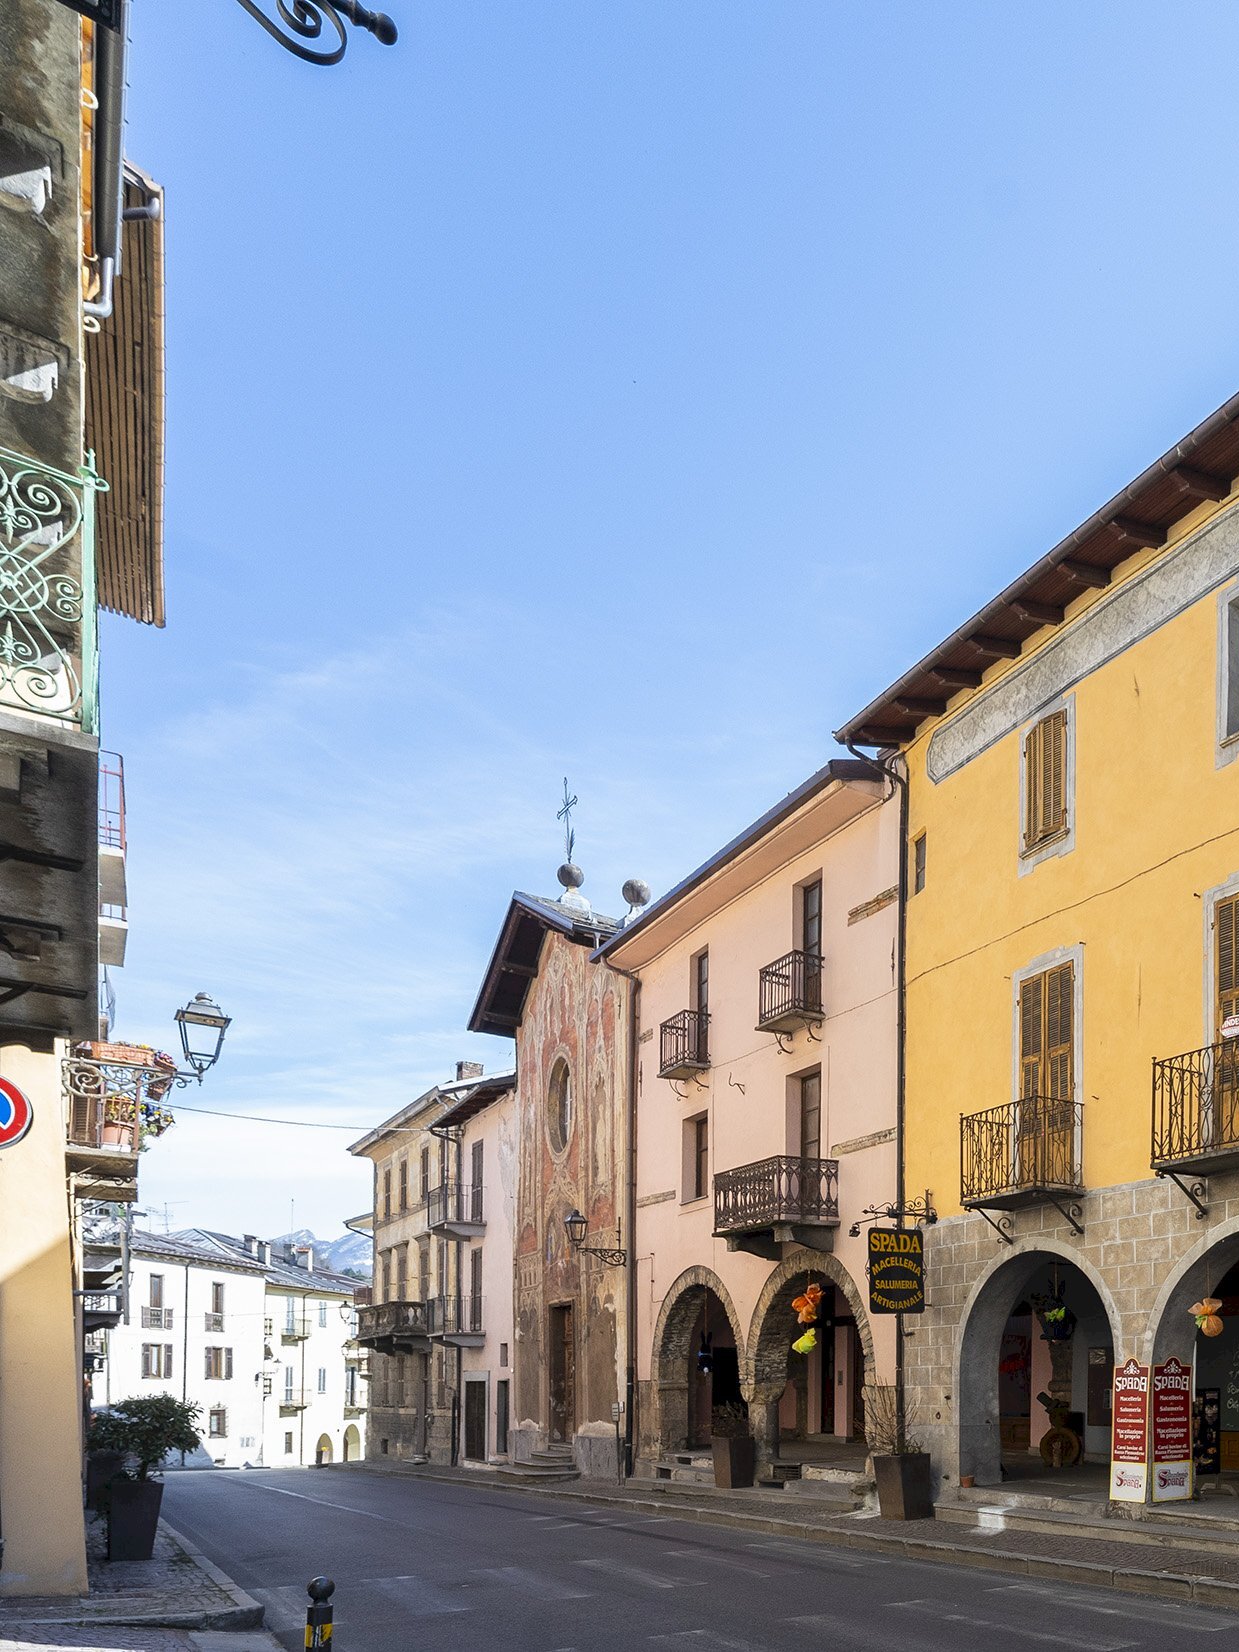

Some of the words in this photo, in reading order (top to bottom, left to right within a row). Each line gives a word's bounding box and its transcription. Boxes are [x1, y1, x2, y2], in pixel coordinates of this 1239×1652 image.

[870, 1232, 922, 1253] SPADA
[872, 1257, 922, 1276] MACELLERIA
[875, 1280, 918, 1290] SALUMERIA
[871, 1290, 924, 1310] ARTIGIANALE
[1116, 1376, 1147, 1392] SPADA
[1154, 1376, 1189, 1391] SPADA
